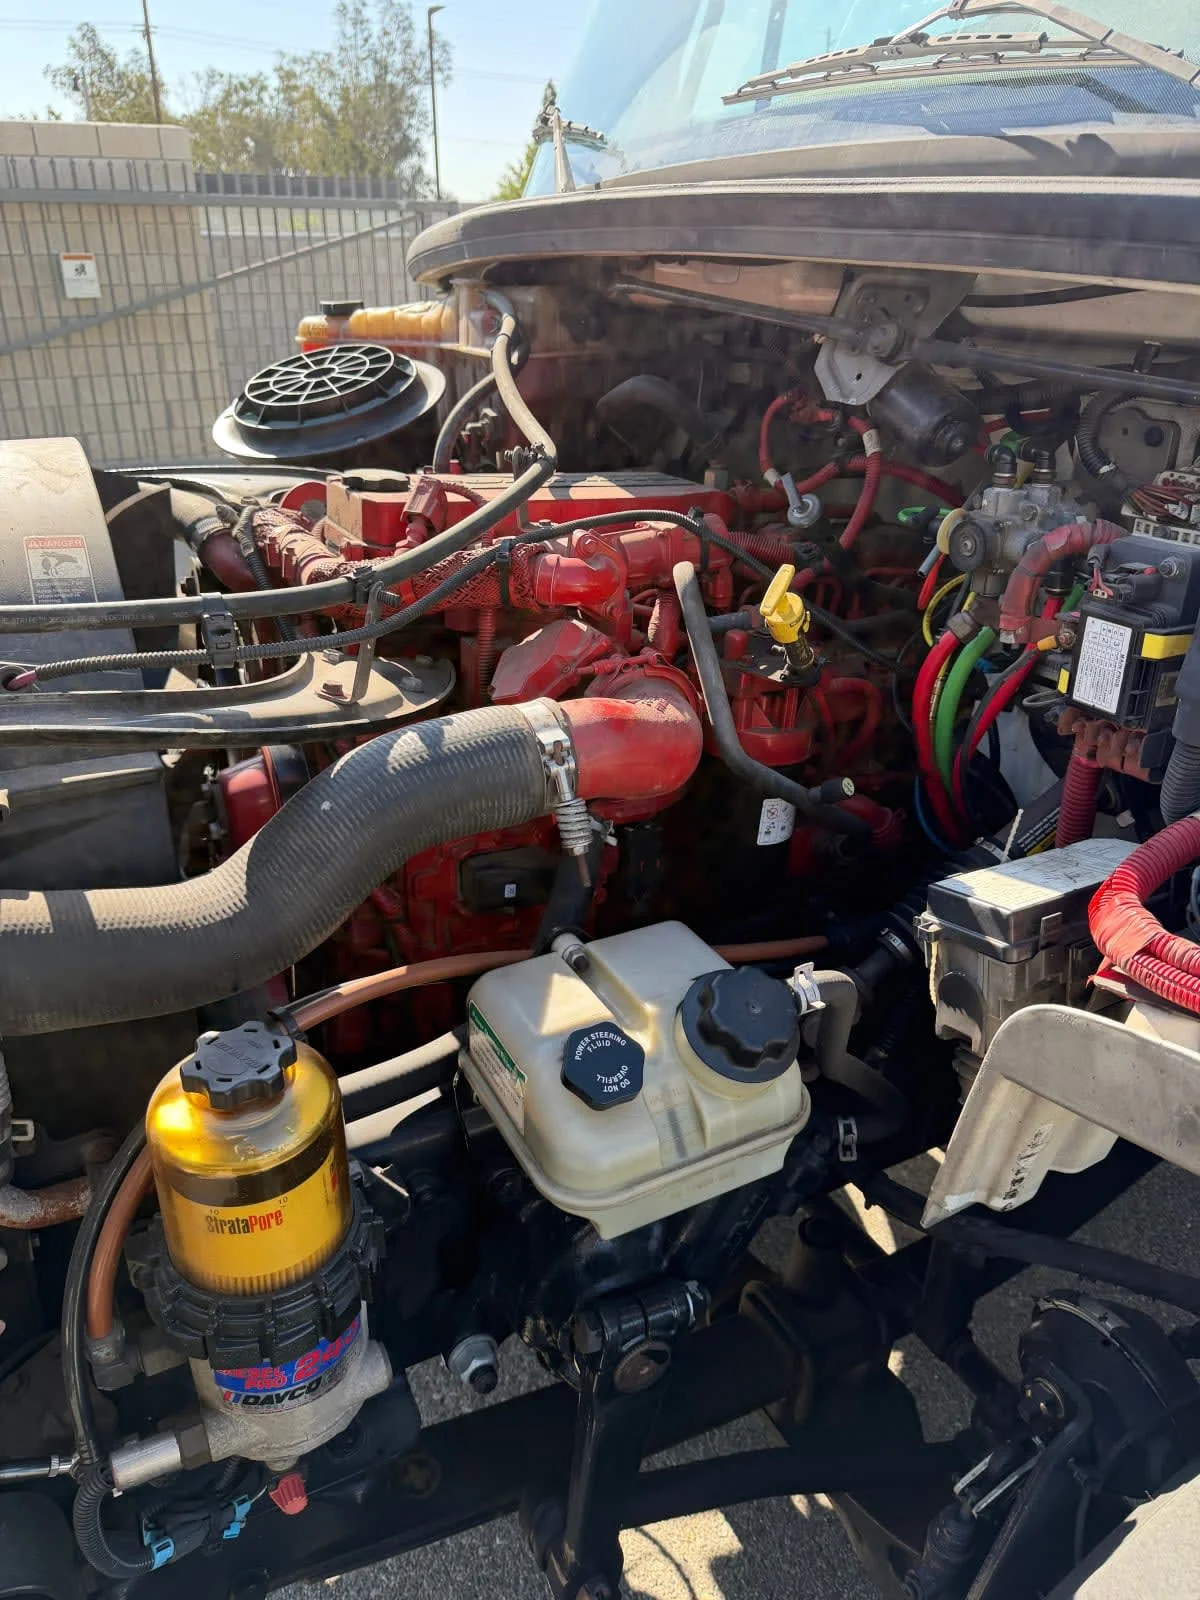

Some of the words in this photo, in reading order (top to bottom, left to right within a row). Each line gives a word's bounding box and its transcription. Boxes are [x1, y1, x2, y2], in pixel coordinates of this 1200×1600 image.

[39, 539, 82, 548] DANGER
[574, 1037, 591, 1061] POWER
[590, 1032, 627, 1046] STEERING
[587, 1040, 611, 1053] FLUID
[596, 1065, 629, 1084] OVERFILL
[603, 1084, 619, 1093] NOT
[620, 1078, 631, 1089] DO
[206, 1209, 284, 1235] StrataPore
